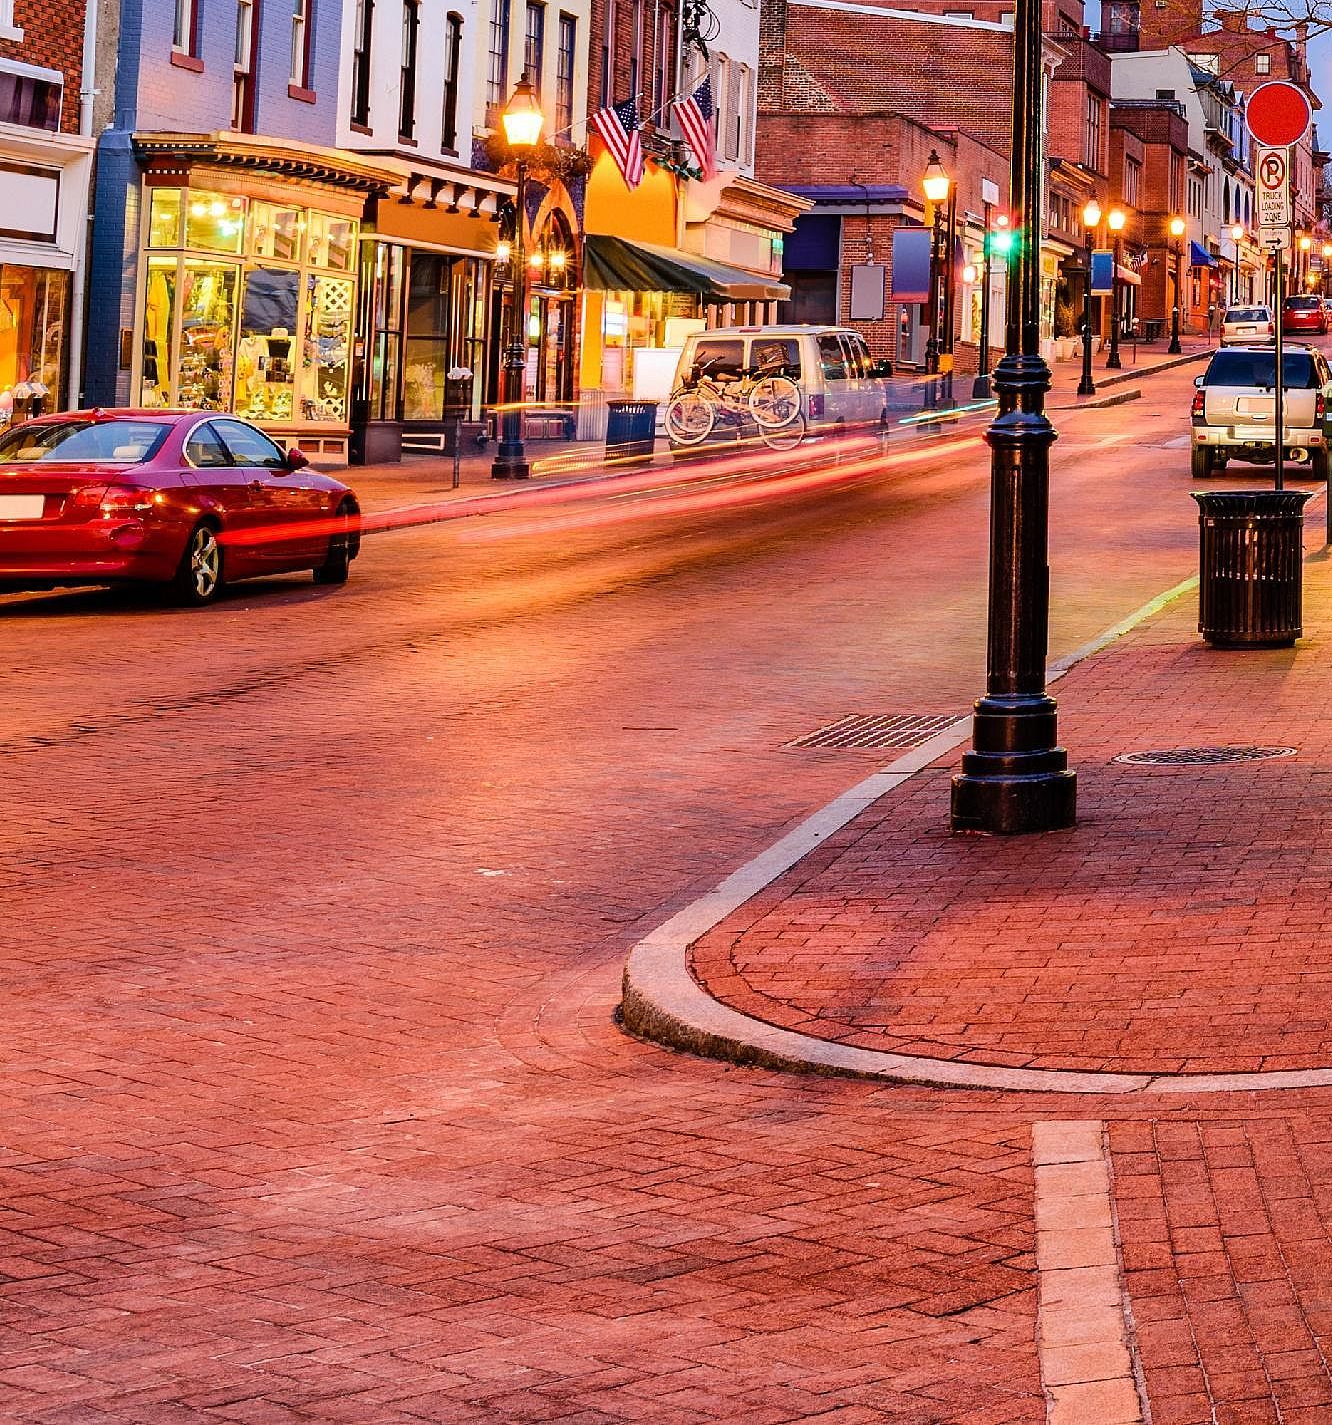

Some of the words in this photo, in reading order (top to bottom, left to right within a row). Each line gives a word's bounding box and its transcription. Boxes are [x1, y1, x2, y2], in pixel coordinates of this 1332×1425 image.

[1262, 191, 1283, 200] TRUCK
[1262, 201, 1284, 211] LOADING
[1264, 212, 1282, 221] ZONE
